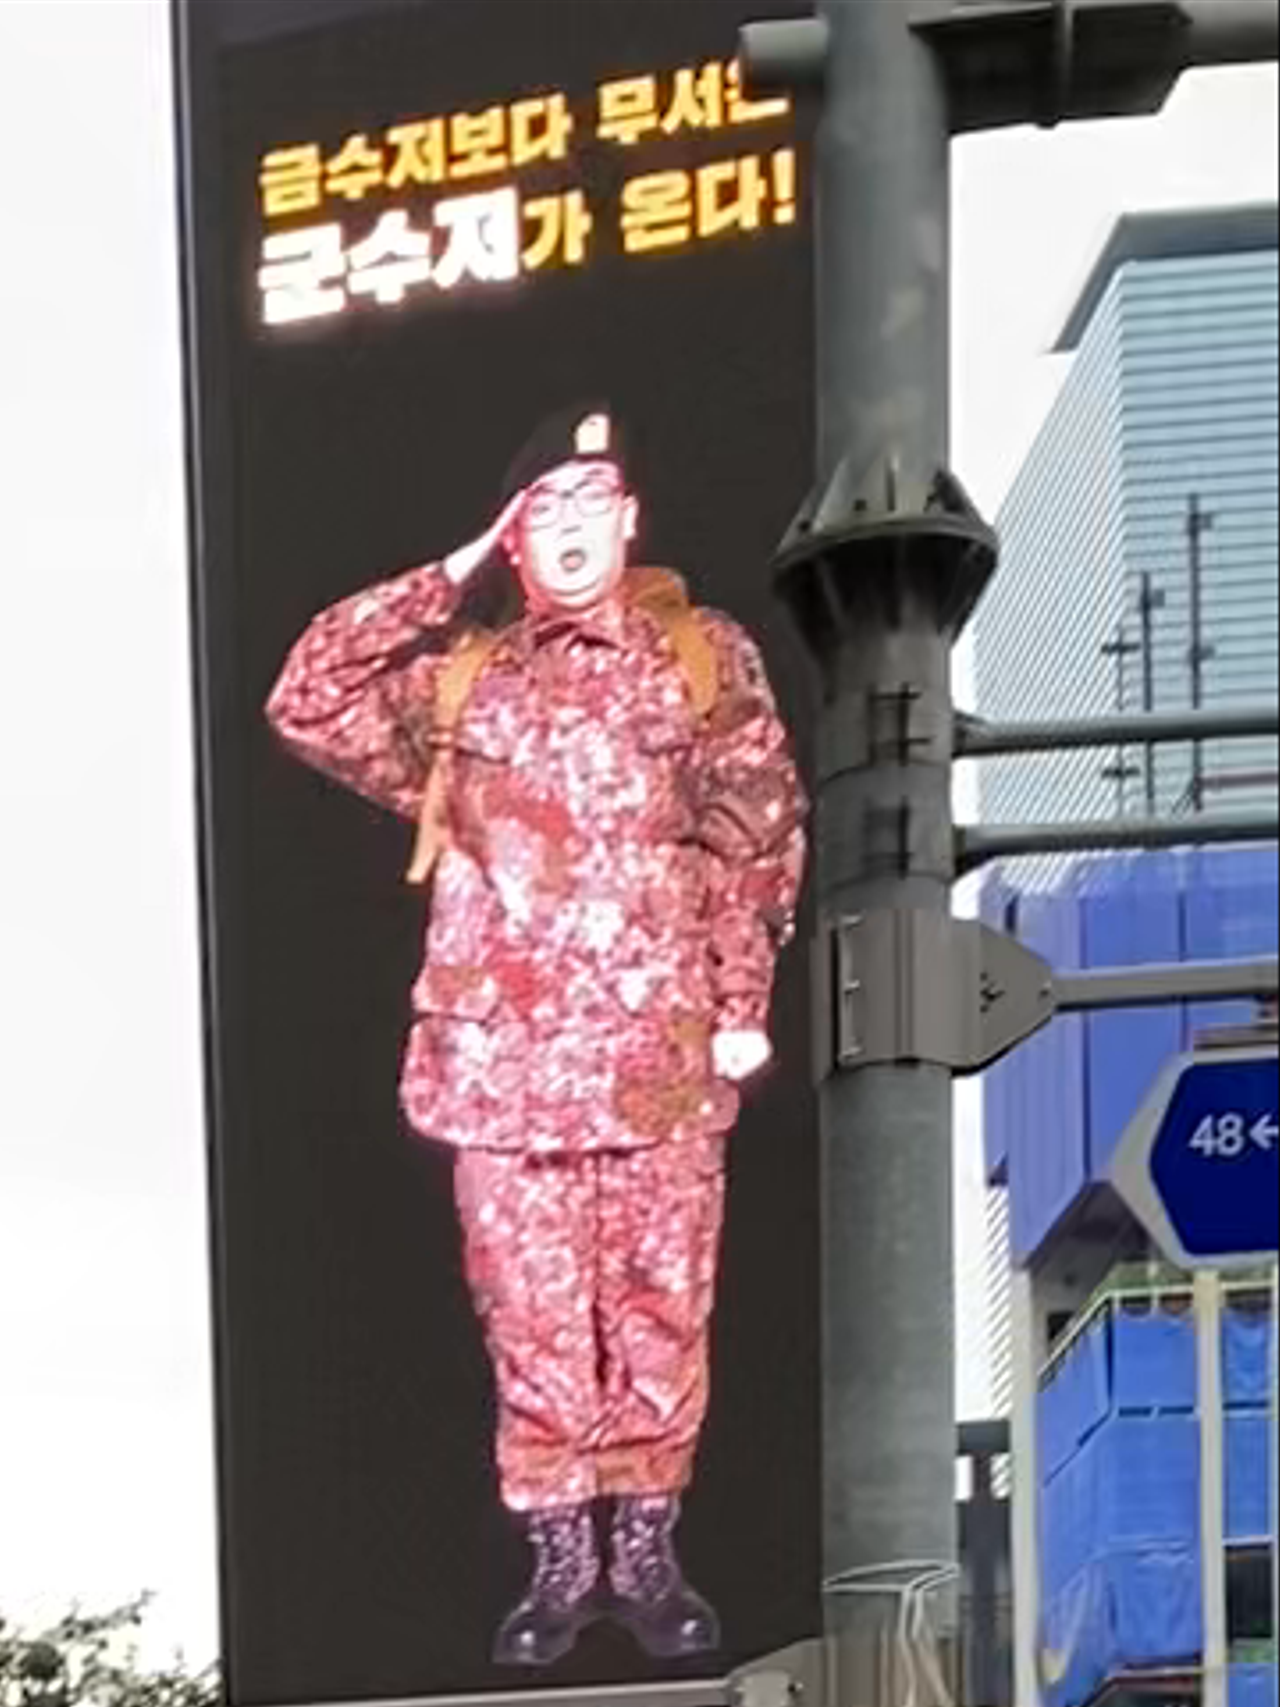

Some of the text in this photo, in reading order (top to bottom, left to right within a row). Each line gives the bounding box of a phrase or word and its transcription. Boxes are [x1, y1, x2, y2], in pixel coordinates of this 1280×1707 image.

[259, 93, 573, 216] 금수저보다
[620, 149, 796, 254] 온다!
[1189, 1111, 1246, 1157] 48
